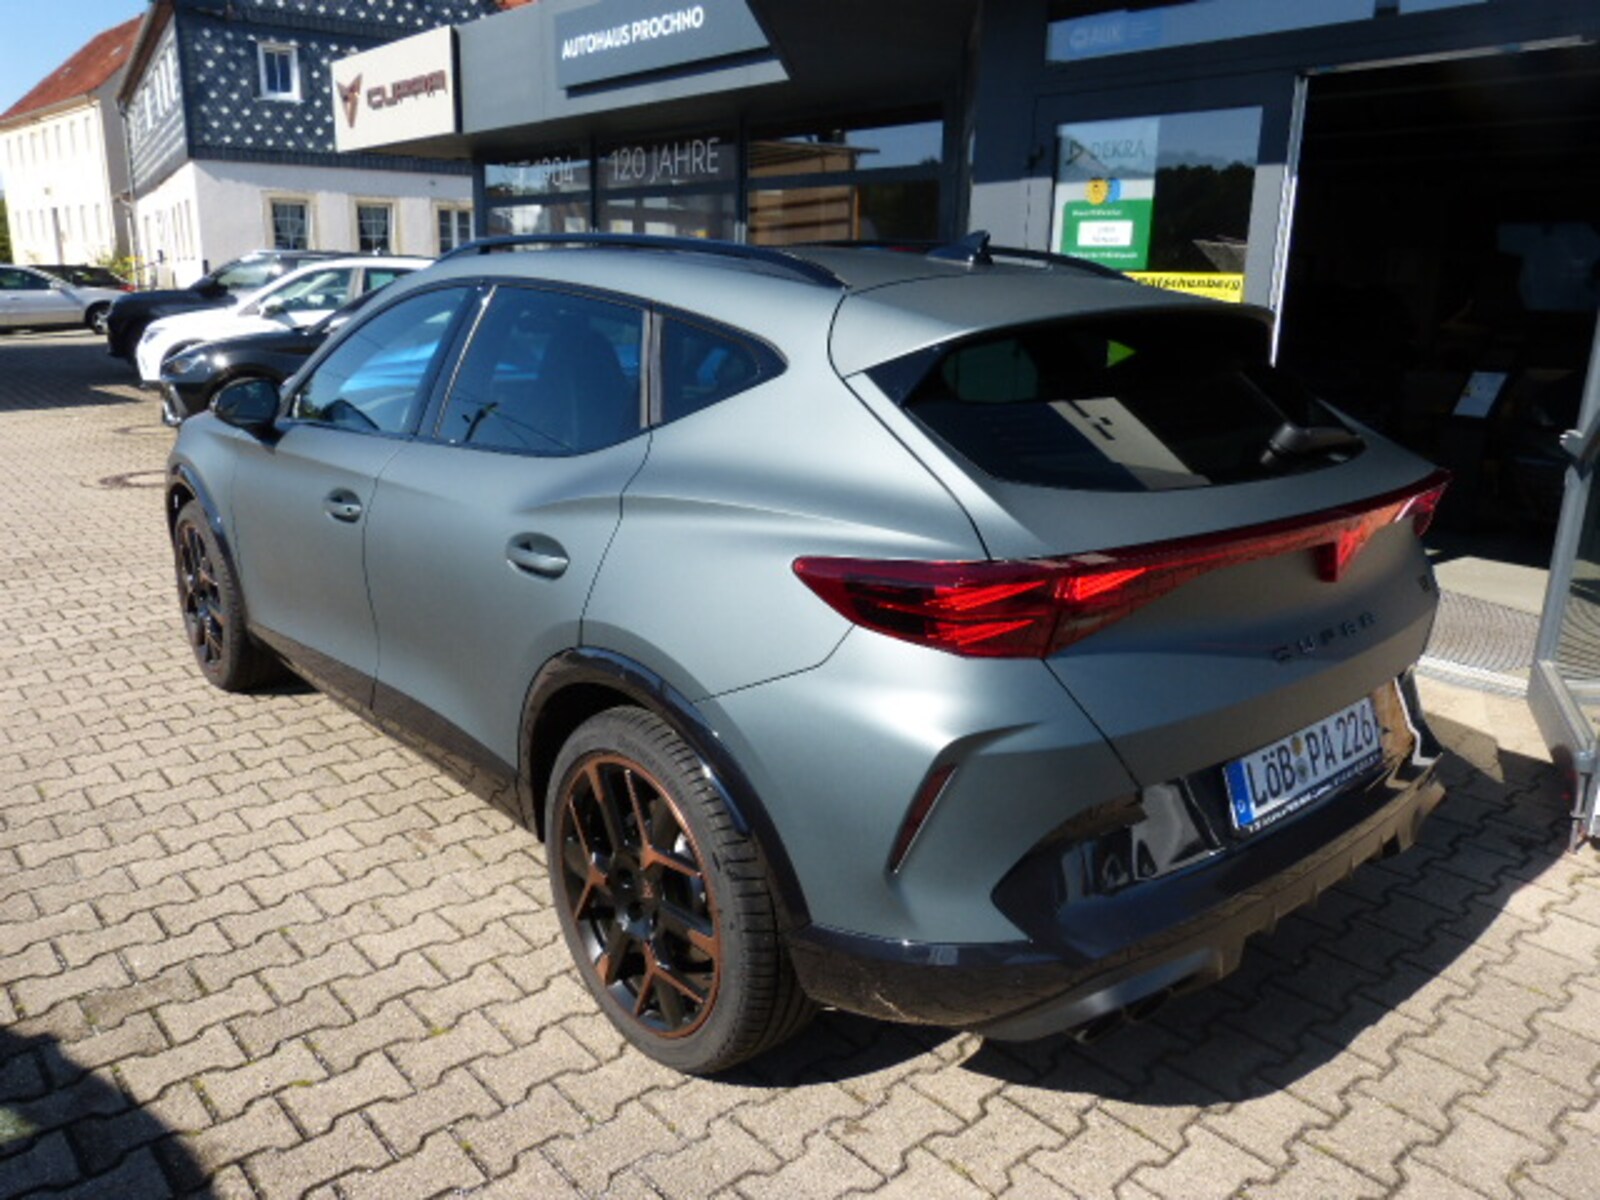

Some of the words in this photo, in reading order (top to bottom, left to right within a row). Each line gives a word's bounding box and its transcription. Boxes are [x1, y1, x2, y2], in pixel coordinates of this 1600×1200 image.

[562, 24, 630, 60] AUTOHAUS
[631, 5, 704, 43] PROCHNO
[611, 147, 645, 181] 120
[650, 137, 720, 183] JAHRE
[1305, 725, 1338, 776] PA
[1335, 704, 1374, 761] 226
